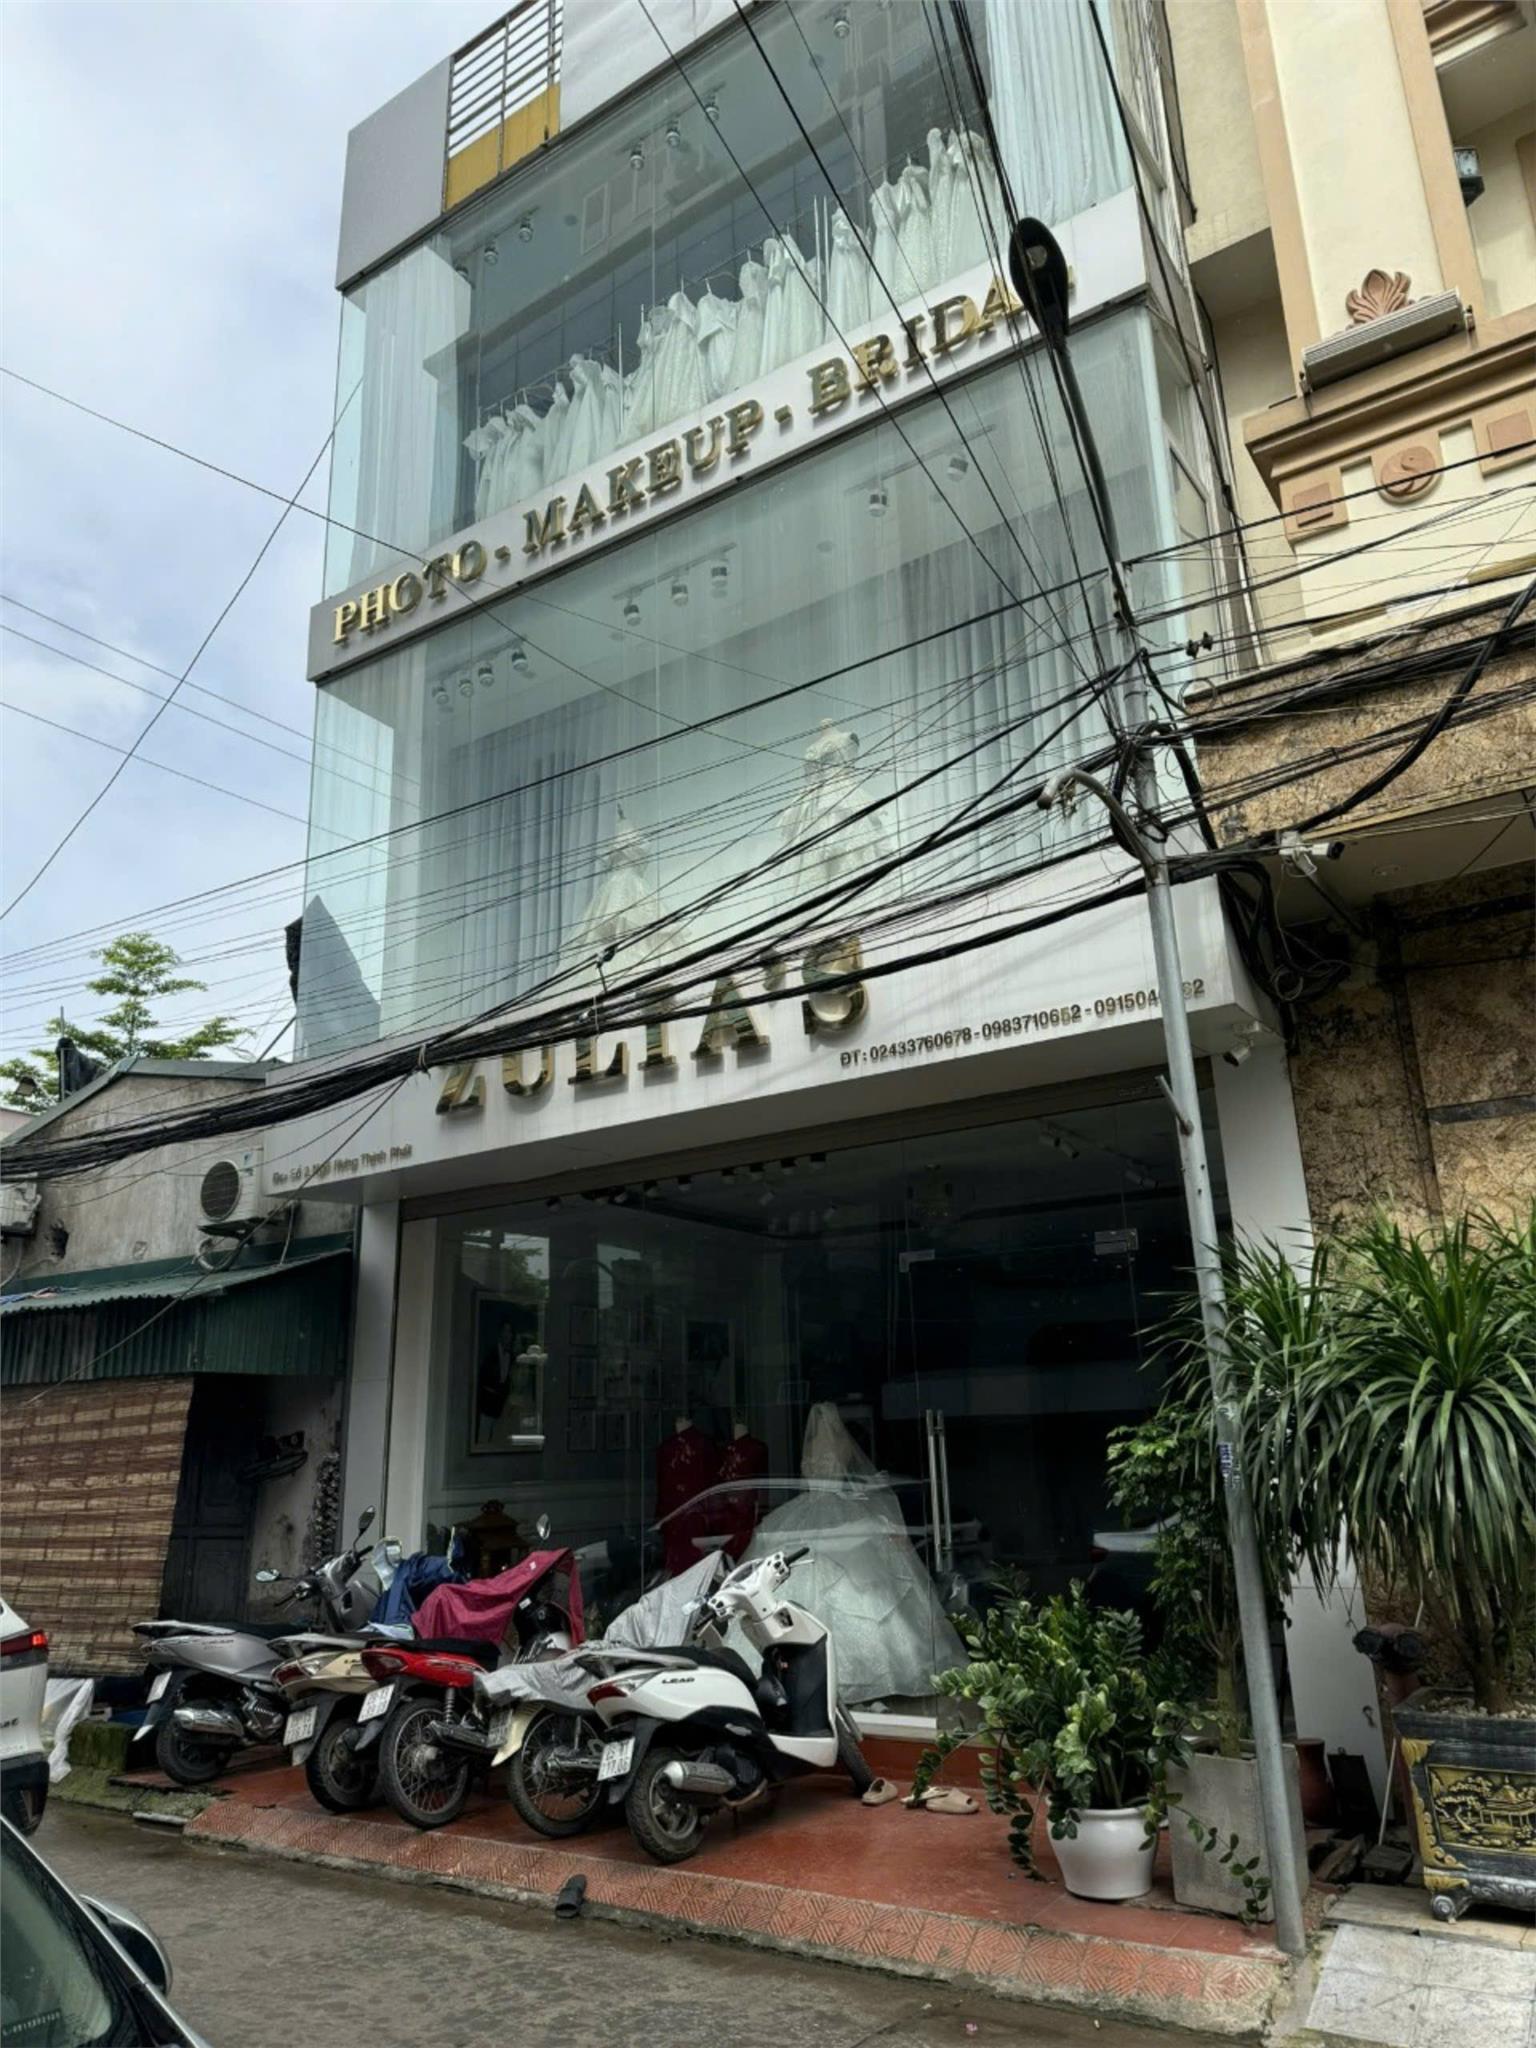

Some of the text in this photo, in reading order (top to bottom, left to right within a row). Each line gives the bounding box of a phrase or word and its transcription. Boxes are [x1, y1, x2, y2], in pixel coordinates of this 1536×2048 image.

[333, 539, 487, 645] PHOTO
[524, 399, 763, 554] MAKEUP
[807, 265, 1076, 414] BRIDA
